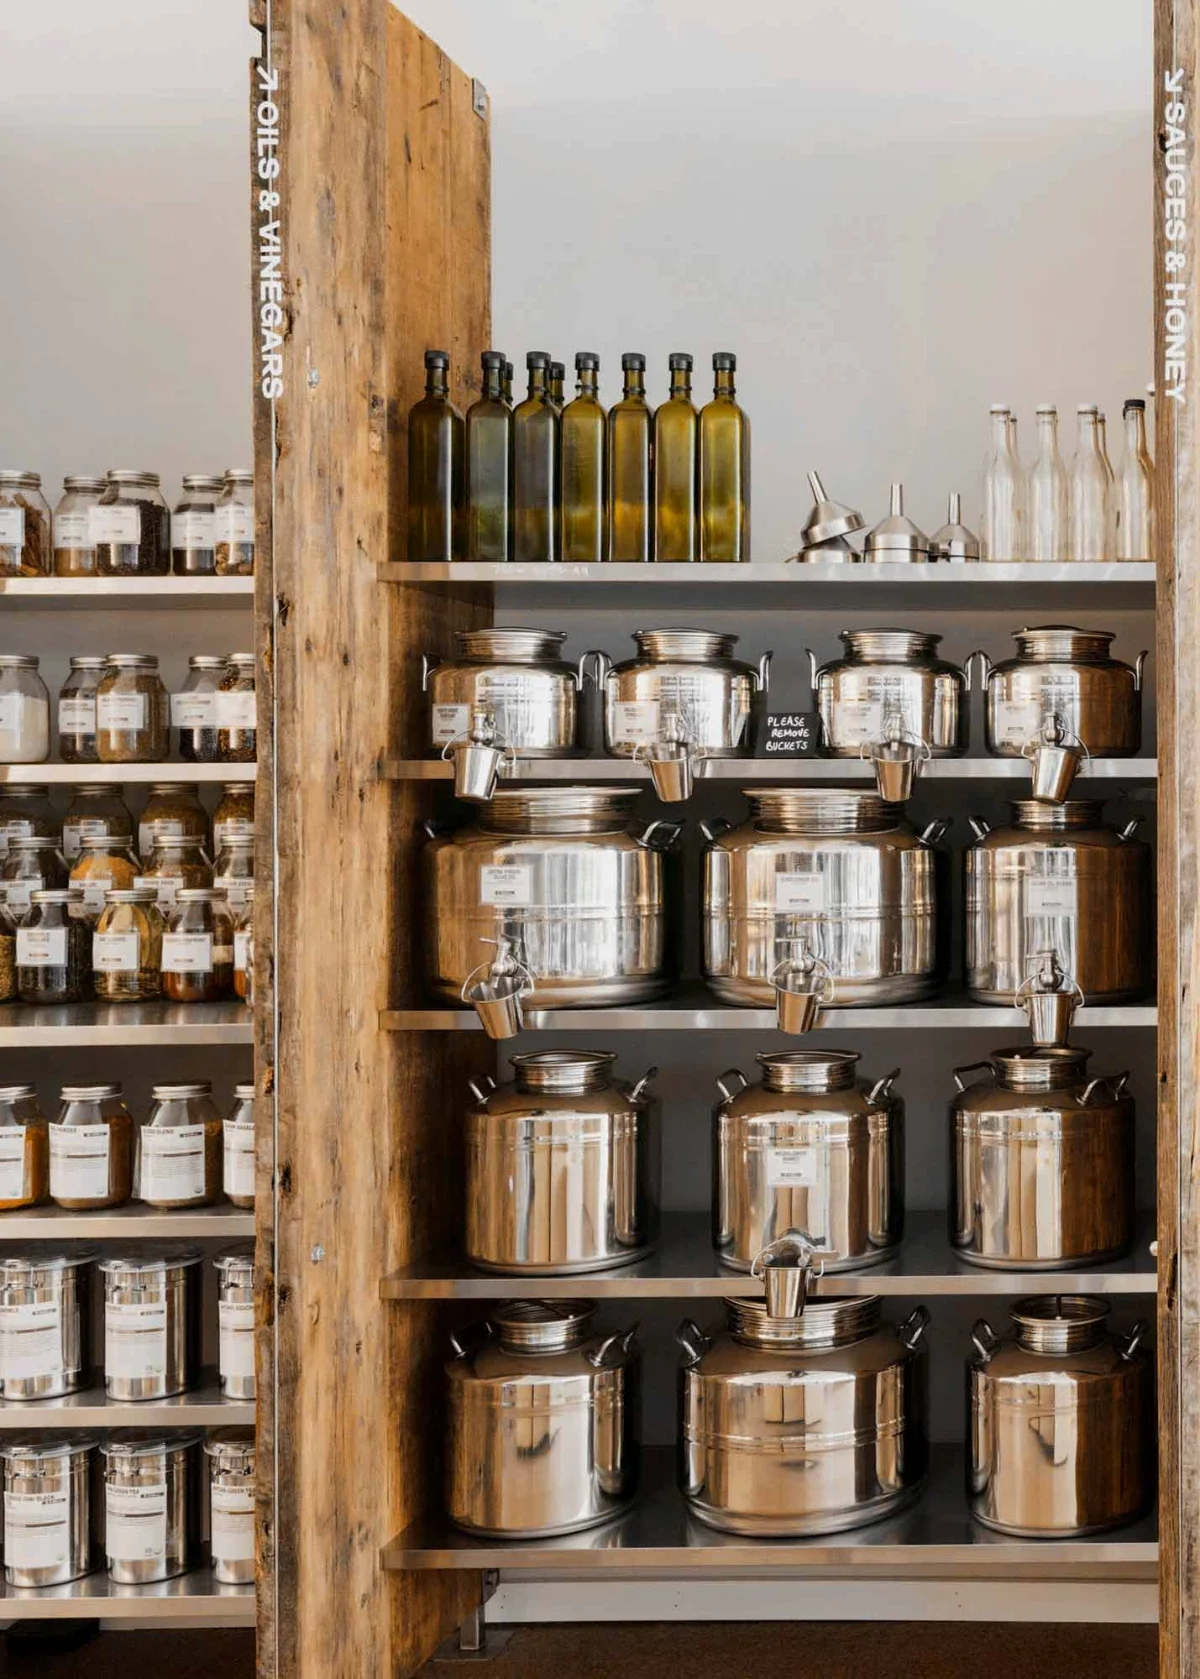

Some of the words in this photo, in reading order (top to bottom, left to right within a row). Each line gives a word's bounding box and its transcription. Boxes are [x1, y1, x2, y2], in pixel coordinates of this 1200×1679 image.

[257, 101, 280, 179] OILS
[1164, 102, 1186, 241] SAUCES
[259, 190, 280, 211] &
[1165, 252, 1186, 273] &
[258, 220, 284, 399] VINEGARS
[1164, 283, 1186, 403] HONEY
[767, 716, 805, 727] PLEASE
[771, 728, 810, 738] REMOVE
[766, 741, 808, 751] BUCKETS
